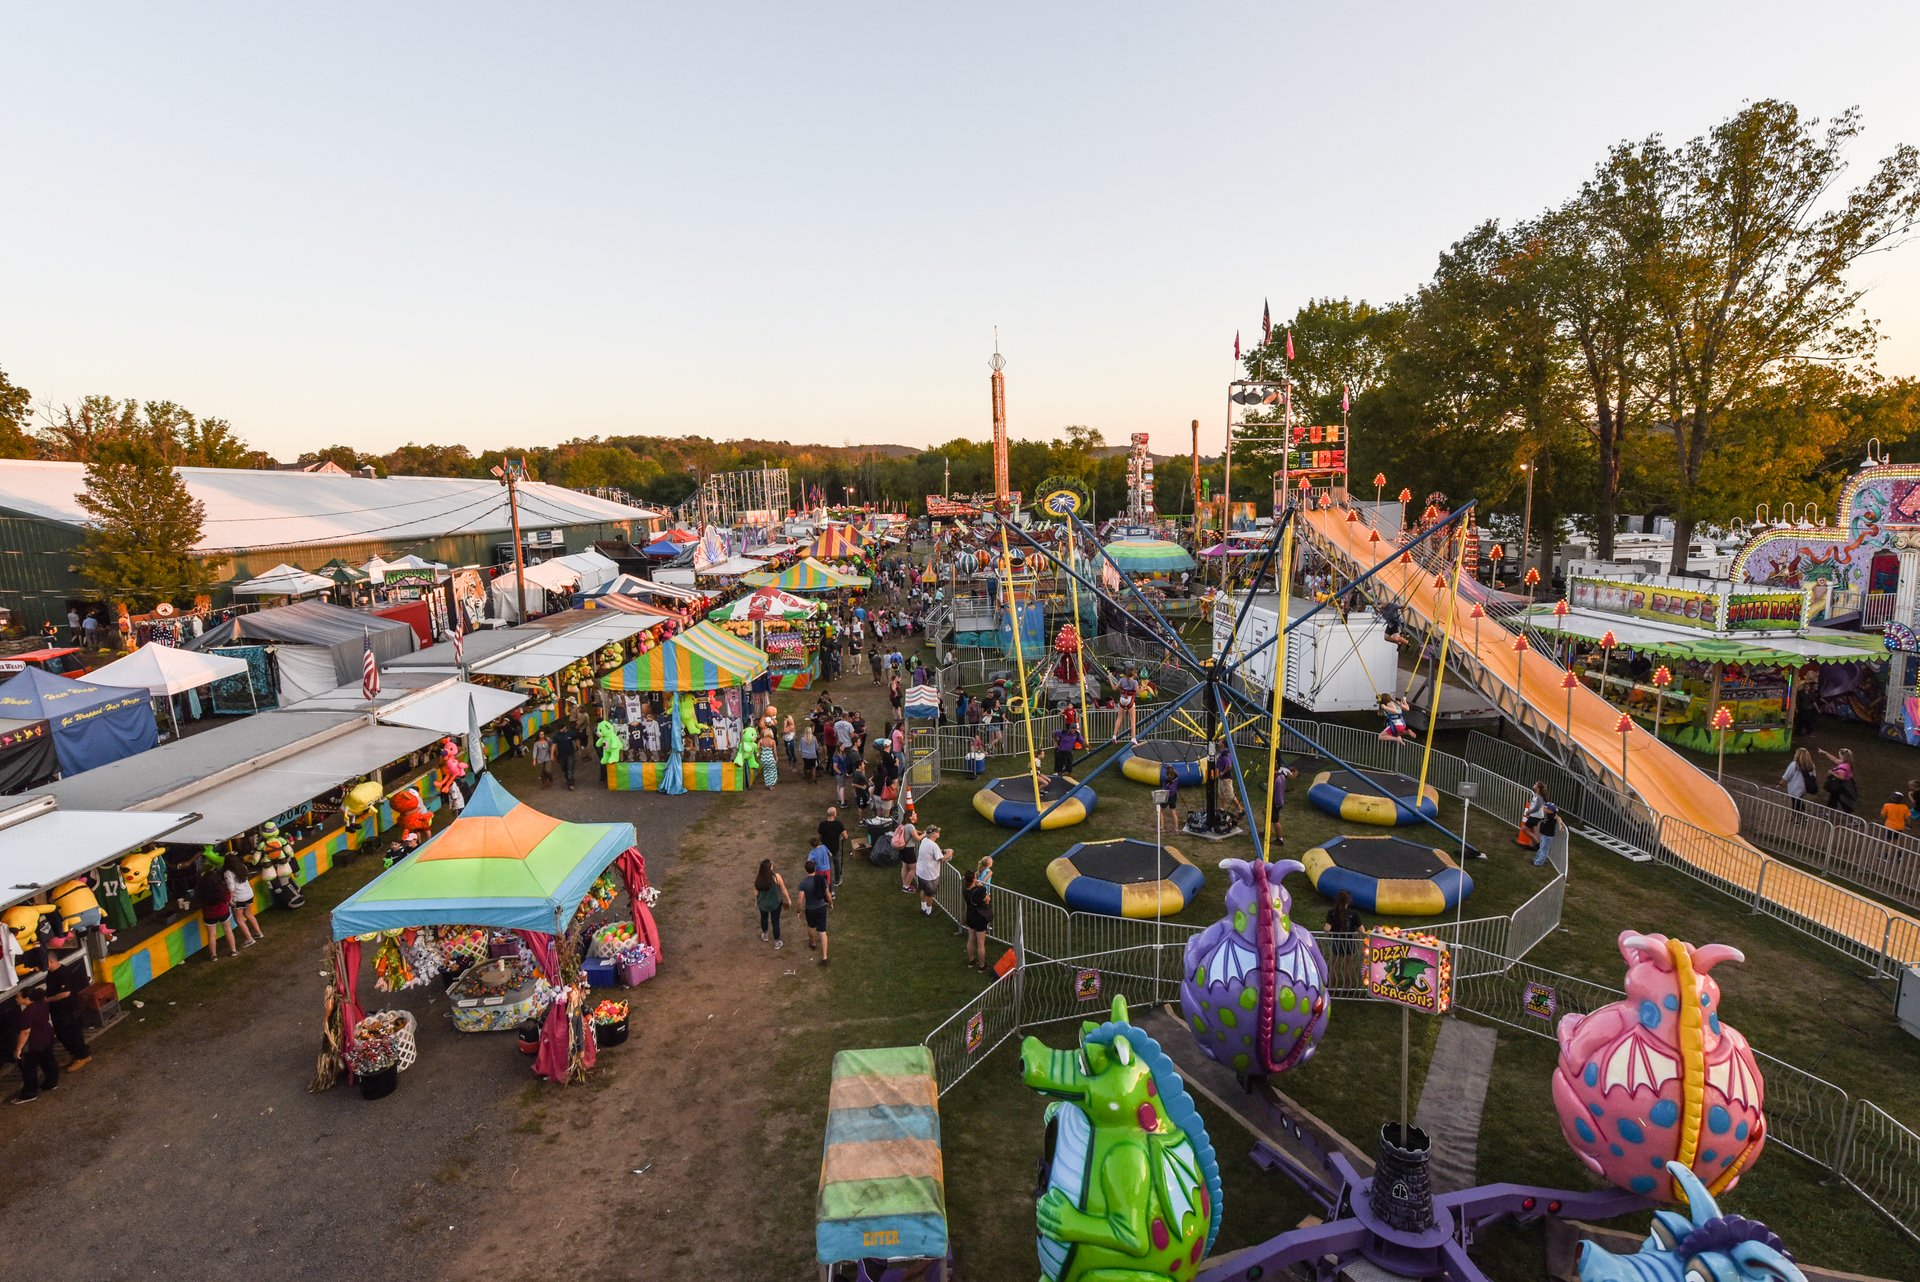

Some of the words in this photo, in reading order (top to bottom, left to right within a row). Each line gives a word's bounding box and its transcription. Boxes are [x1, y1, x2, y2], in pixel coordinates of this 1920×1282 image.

[1293, 425, 1339, 445] FUN
[1288, 450, 1344, 468] SLIDE
[1651, 593, 1717, 622] RACE
[1728, 601, 1769, 623] WATER
[61, 717, 73, 727] Get
[103, 880, 119, 897] 17
[1371, 945, 1410, 963] DIZZY
[1371, 980, 1435, 1010] DRAGONS
[1531, 987, 1550, 996] DIZZY
[1526, 1002, 1551, 1016] DRAGONS
[863, 1230, 900, 1247] ENTER
